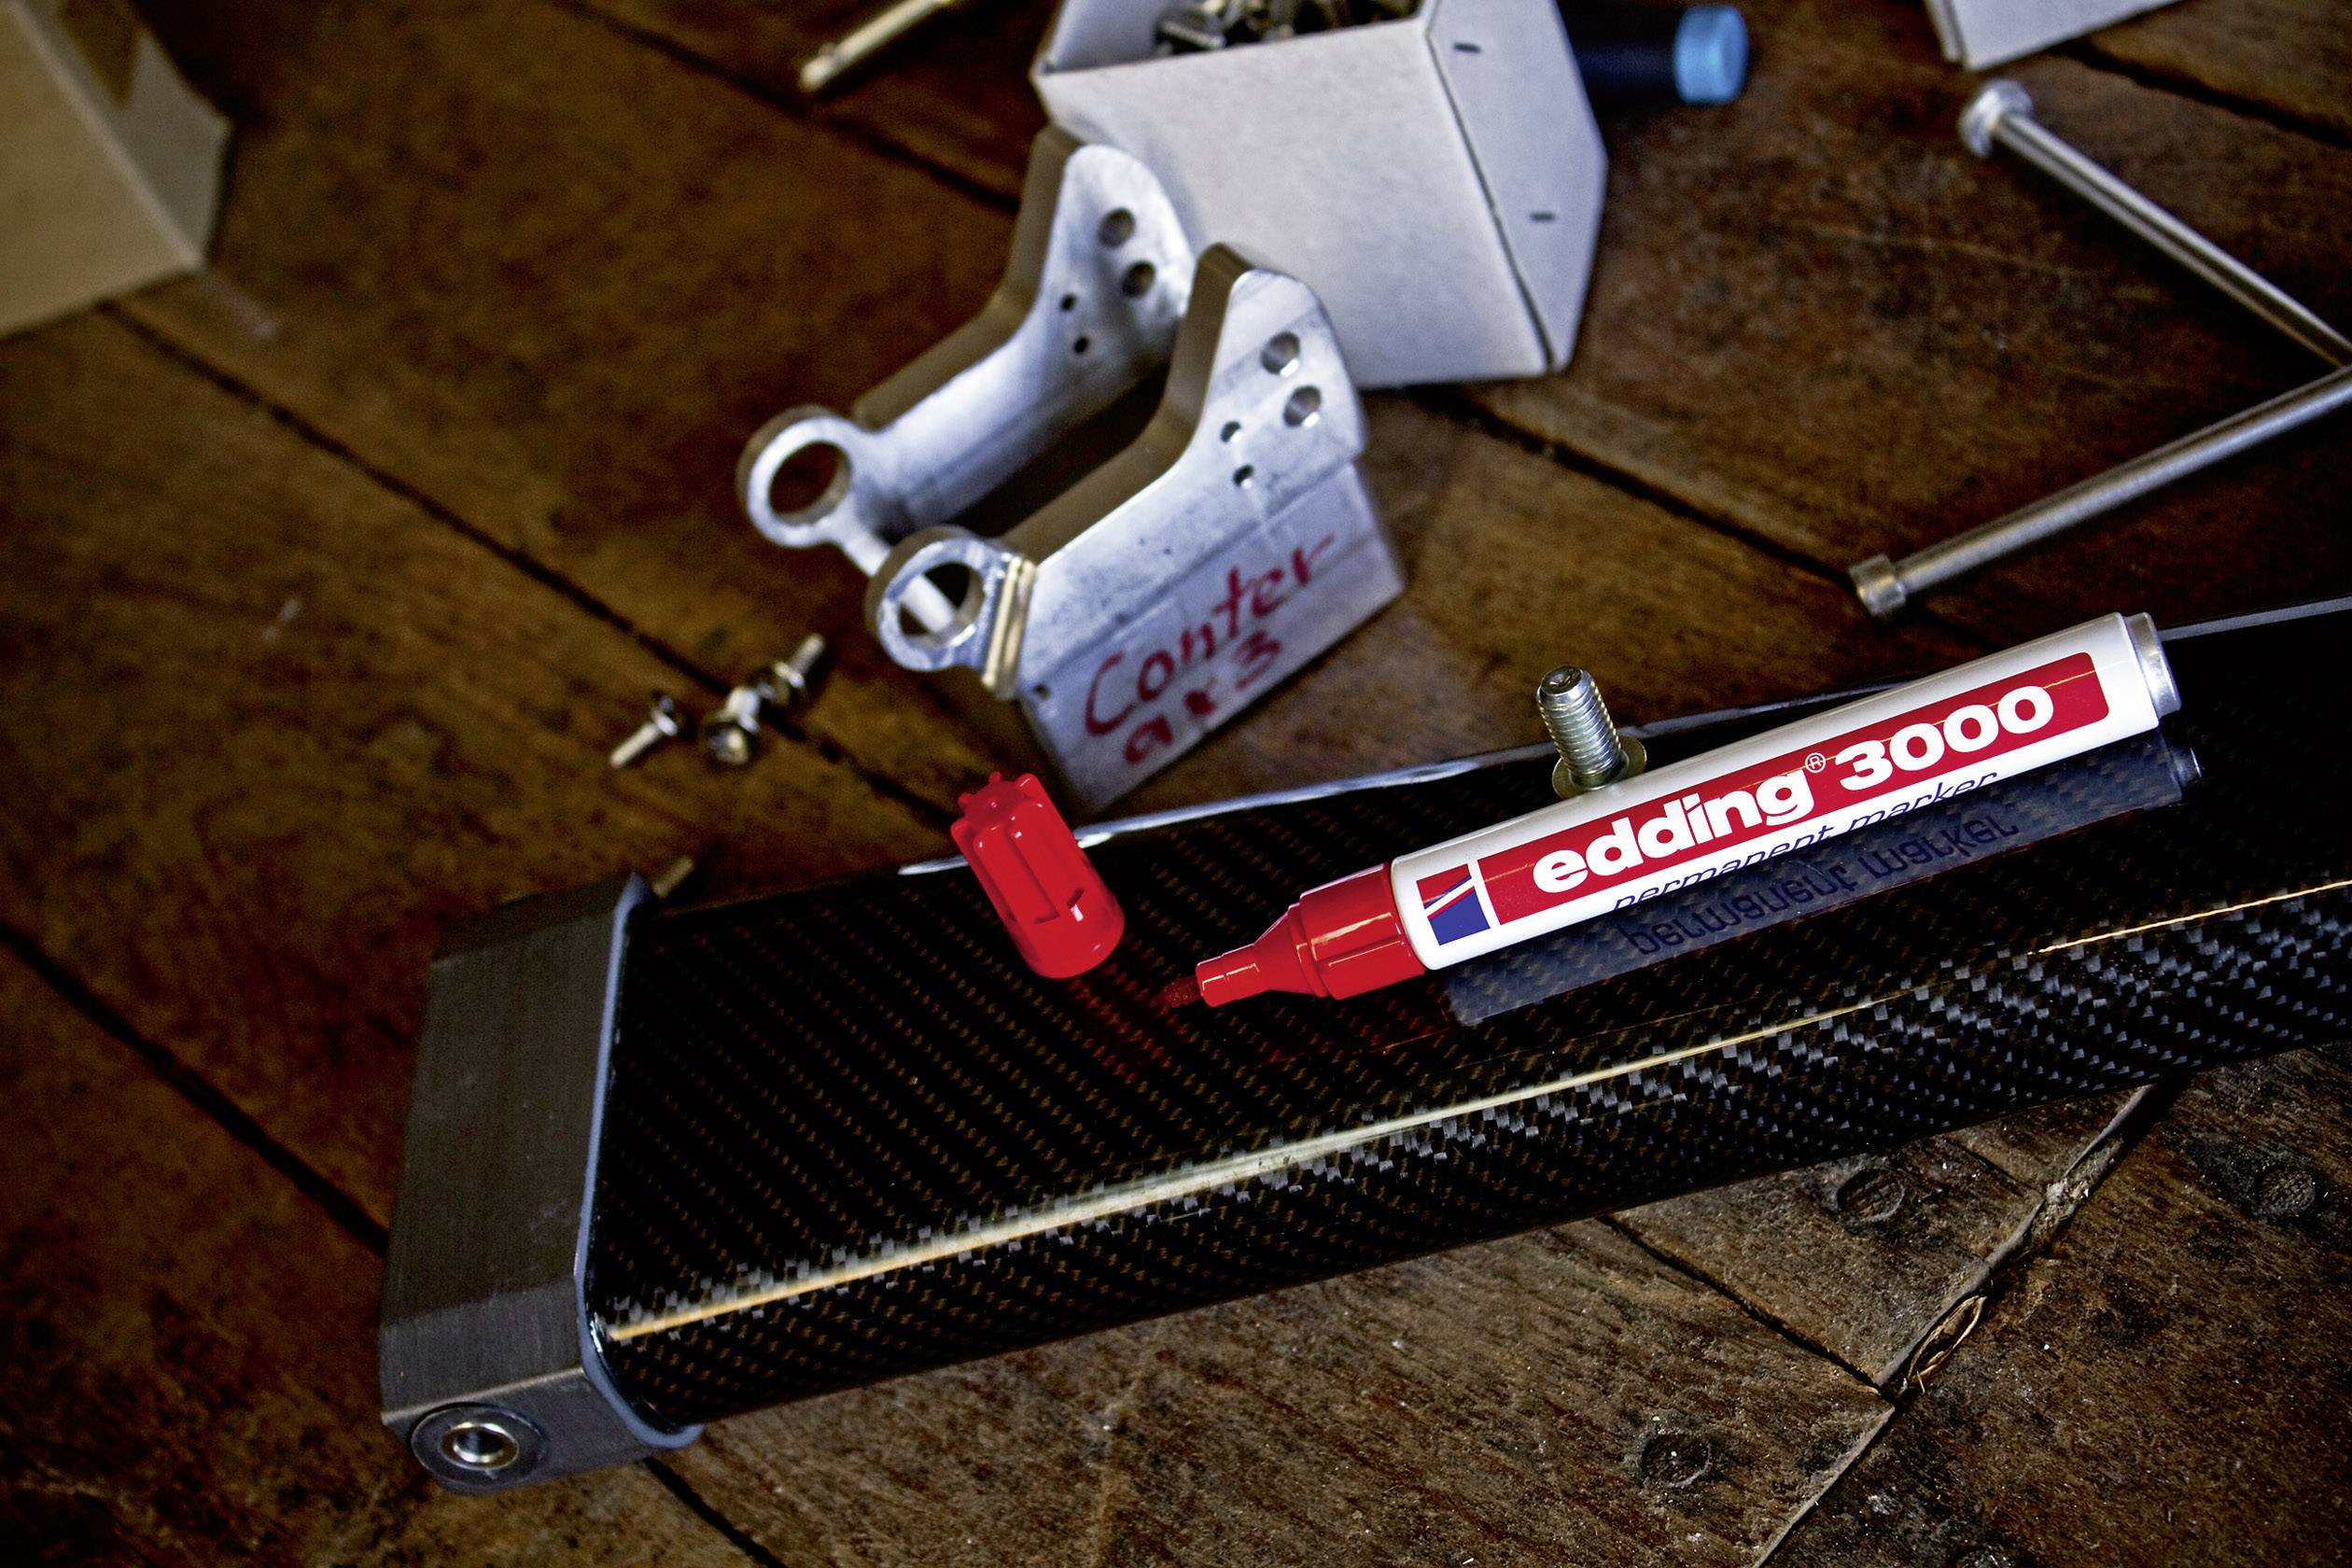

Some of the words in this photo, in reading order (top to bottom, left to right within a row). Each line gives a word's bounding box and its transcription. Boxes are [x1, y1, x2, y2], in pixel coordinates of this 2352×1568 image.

[1834, 685, 2054, 791] 3000
[1613, 824, 1835, 914] permanent
[1846, 771, 1998, 834] marker
